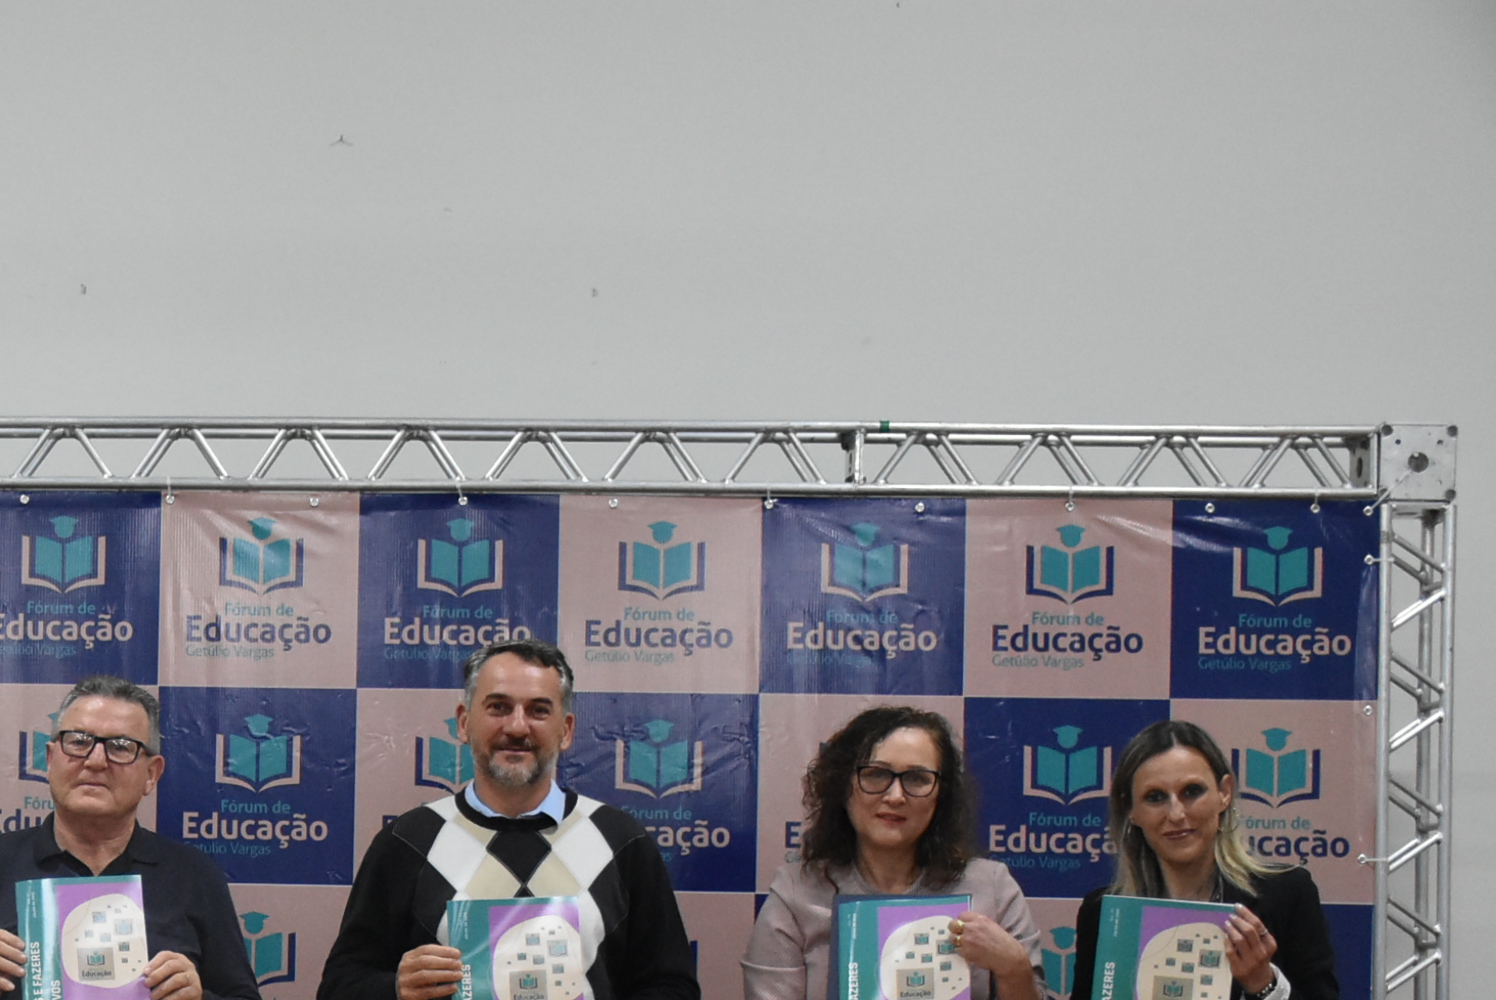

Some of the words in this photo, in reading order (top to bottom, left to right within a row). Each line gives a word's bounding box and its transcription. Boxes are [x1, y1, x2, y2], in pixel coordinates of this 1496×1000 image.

[28, 601, 74, 615] Fórum
[78, 601, 96, 616] de
[225, 603, 271, 617] Fórum
[276, 603, 294, 618] de
[424, 605, 471, 619] Fórum
[475, 605, 493, 620] de
[625, 607, 672, 621] Fórum
[677, 608, 695, 622] de
[1033, 611, 1081, 625] Fórum
[1086, 612, 1104, 626] de
[1239, 613, 1288, 628] Fórum
[1293, 614, 1312, 629] de
[185, 616, 331, 653] Educação
[585, 620, 734, 657] Educação
[787, 623, 938, 660] Educação
[992, 625, 1143, 662] Educação
[1198, 627, 1351, 664] Educação
[233, 646, 274, 662] Vargas
[633, 651, 675, 667] Vargas
[1041, 655, 1083, 671] Vargas
[1248, 658, 1291, 674] Vargas
[24, 797, 56, 811] Fóru
[221, 800, 267, 814] Fórum
[272, 801, 290, 815] de
[673, 807, 691, 821] de
[1028, 812, 1077, 826] Fórum
[1081, 813, 1100, 827] de
[182, 813, 328, 850] Educação
[1289, 816, 1307, 831] de
[229, 843, 270, 859] Vargas
[1037, 856, 1079, 872] Vargas
[30, 941, 42, 987] FAZERES
[33, 988, 43, 996] E
